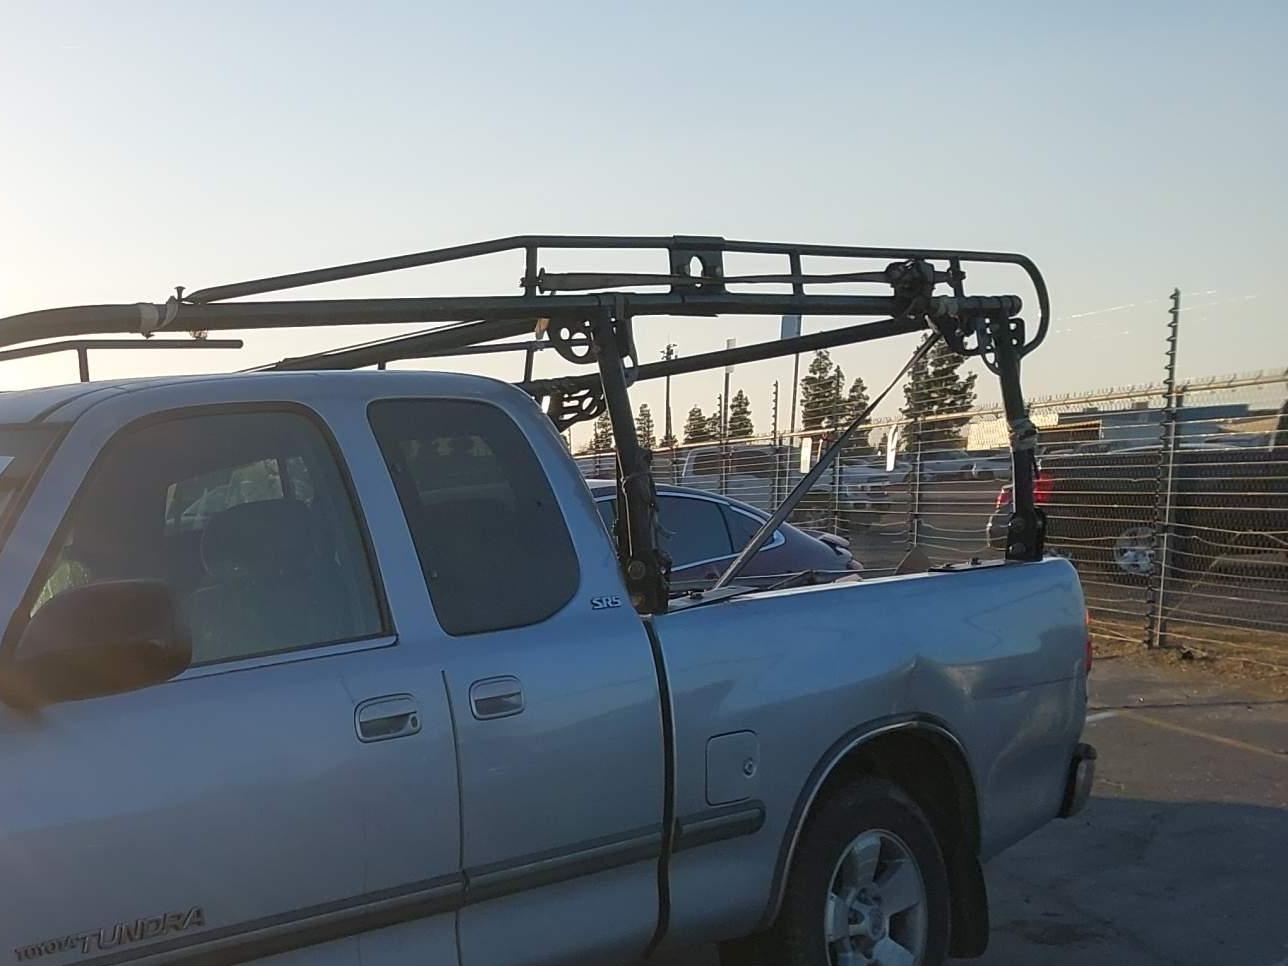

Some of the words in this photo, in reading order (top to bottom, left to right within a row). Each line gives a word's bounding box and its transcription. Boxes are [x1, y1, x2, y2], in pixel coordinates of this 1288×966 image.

[590, 595, 622, 610] SR5
[13, 934, 79, 961] TOYOTA
[79, 904, 207, 954] TUNDRA
